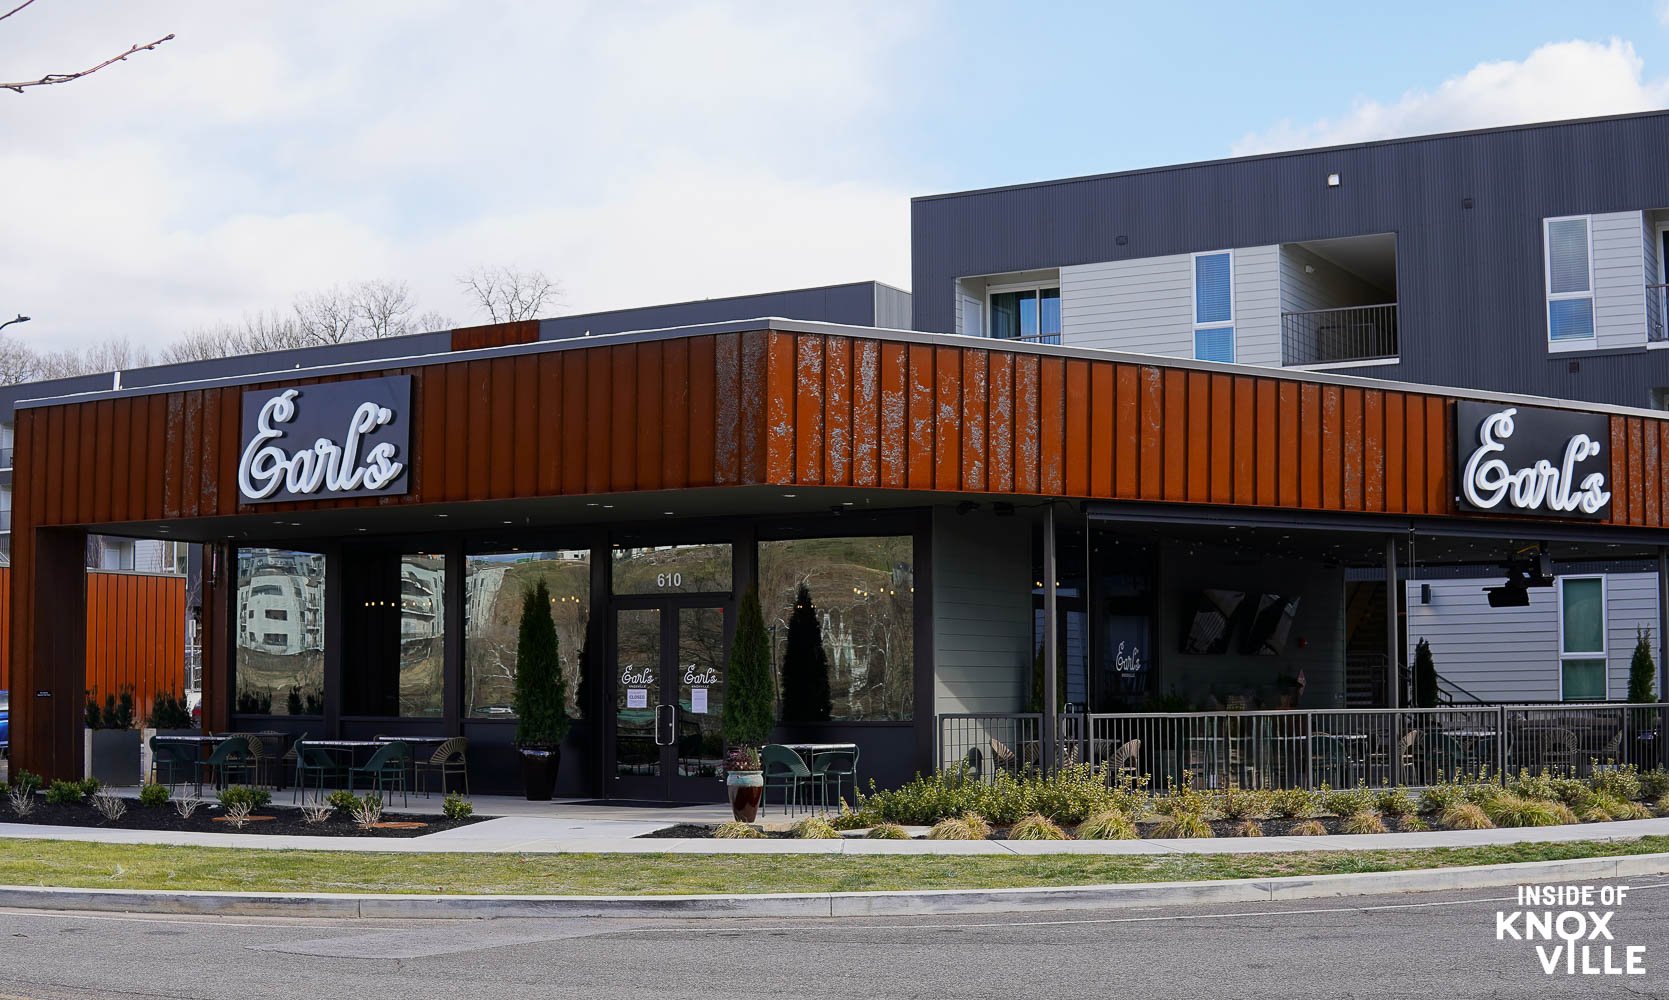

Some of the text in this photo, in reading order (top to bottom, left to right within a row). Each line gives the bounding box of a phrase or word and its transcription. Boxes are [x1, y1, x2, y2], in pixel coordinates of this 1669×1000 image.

[238, 389, 402, 498] Earl's
[1463, 407, 1611, 513] Earl's
[657, 572, 682, 587] 610
[1115, 640, 1141, 671] Earl's
[621, 664, 654, 684] Earl's
[683, 664, 717, 684] Earl's
